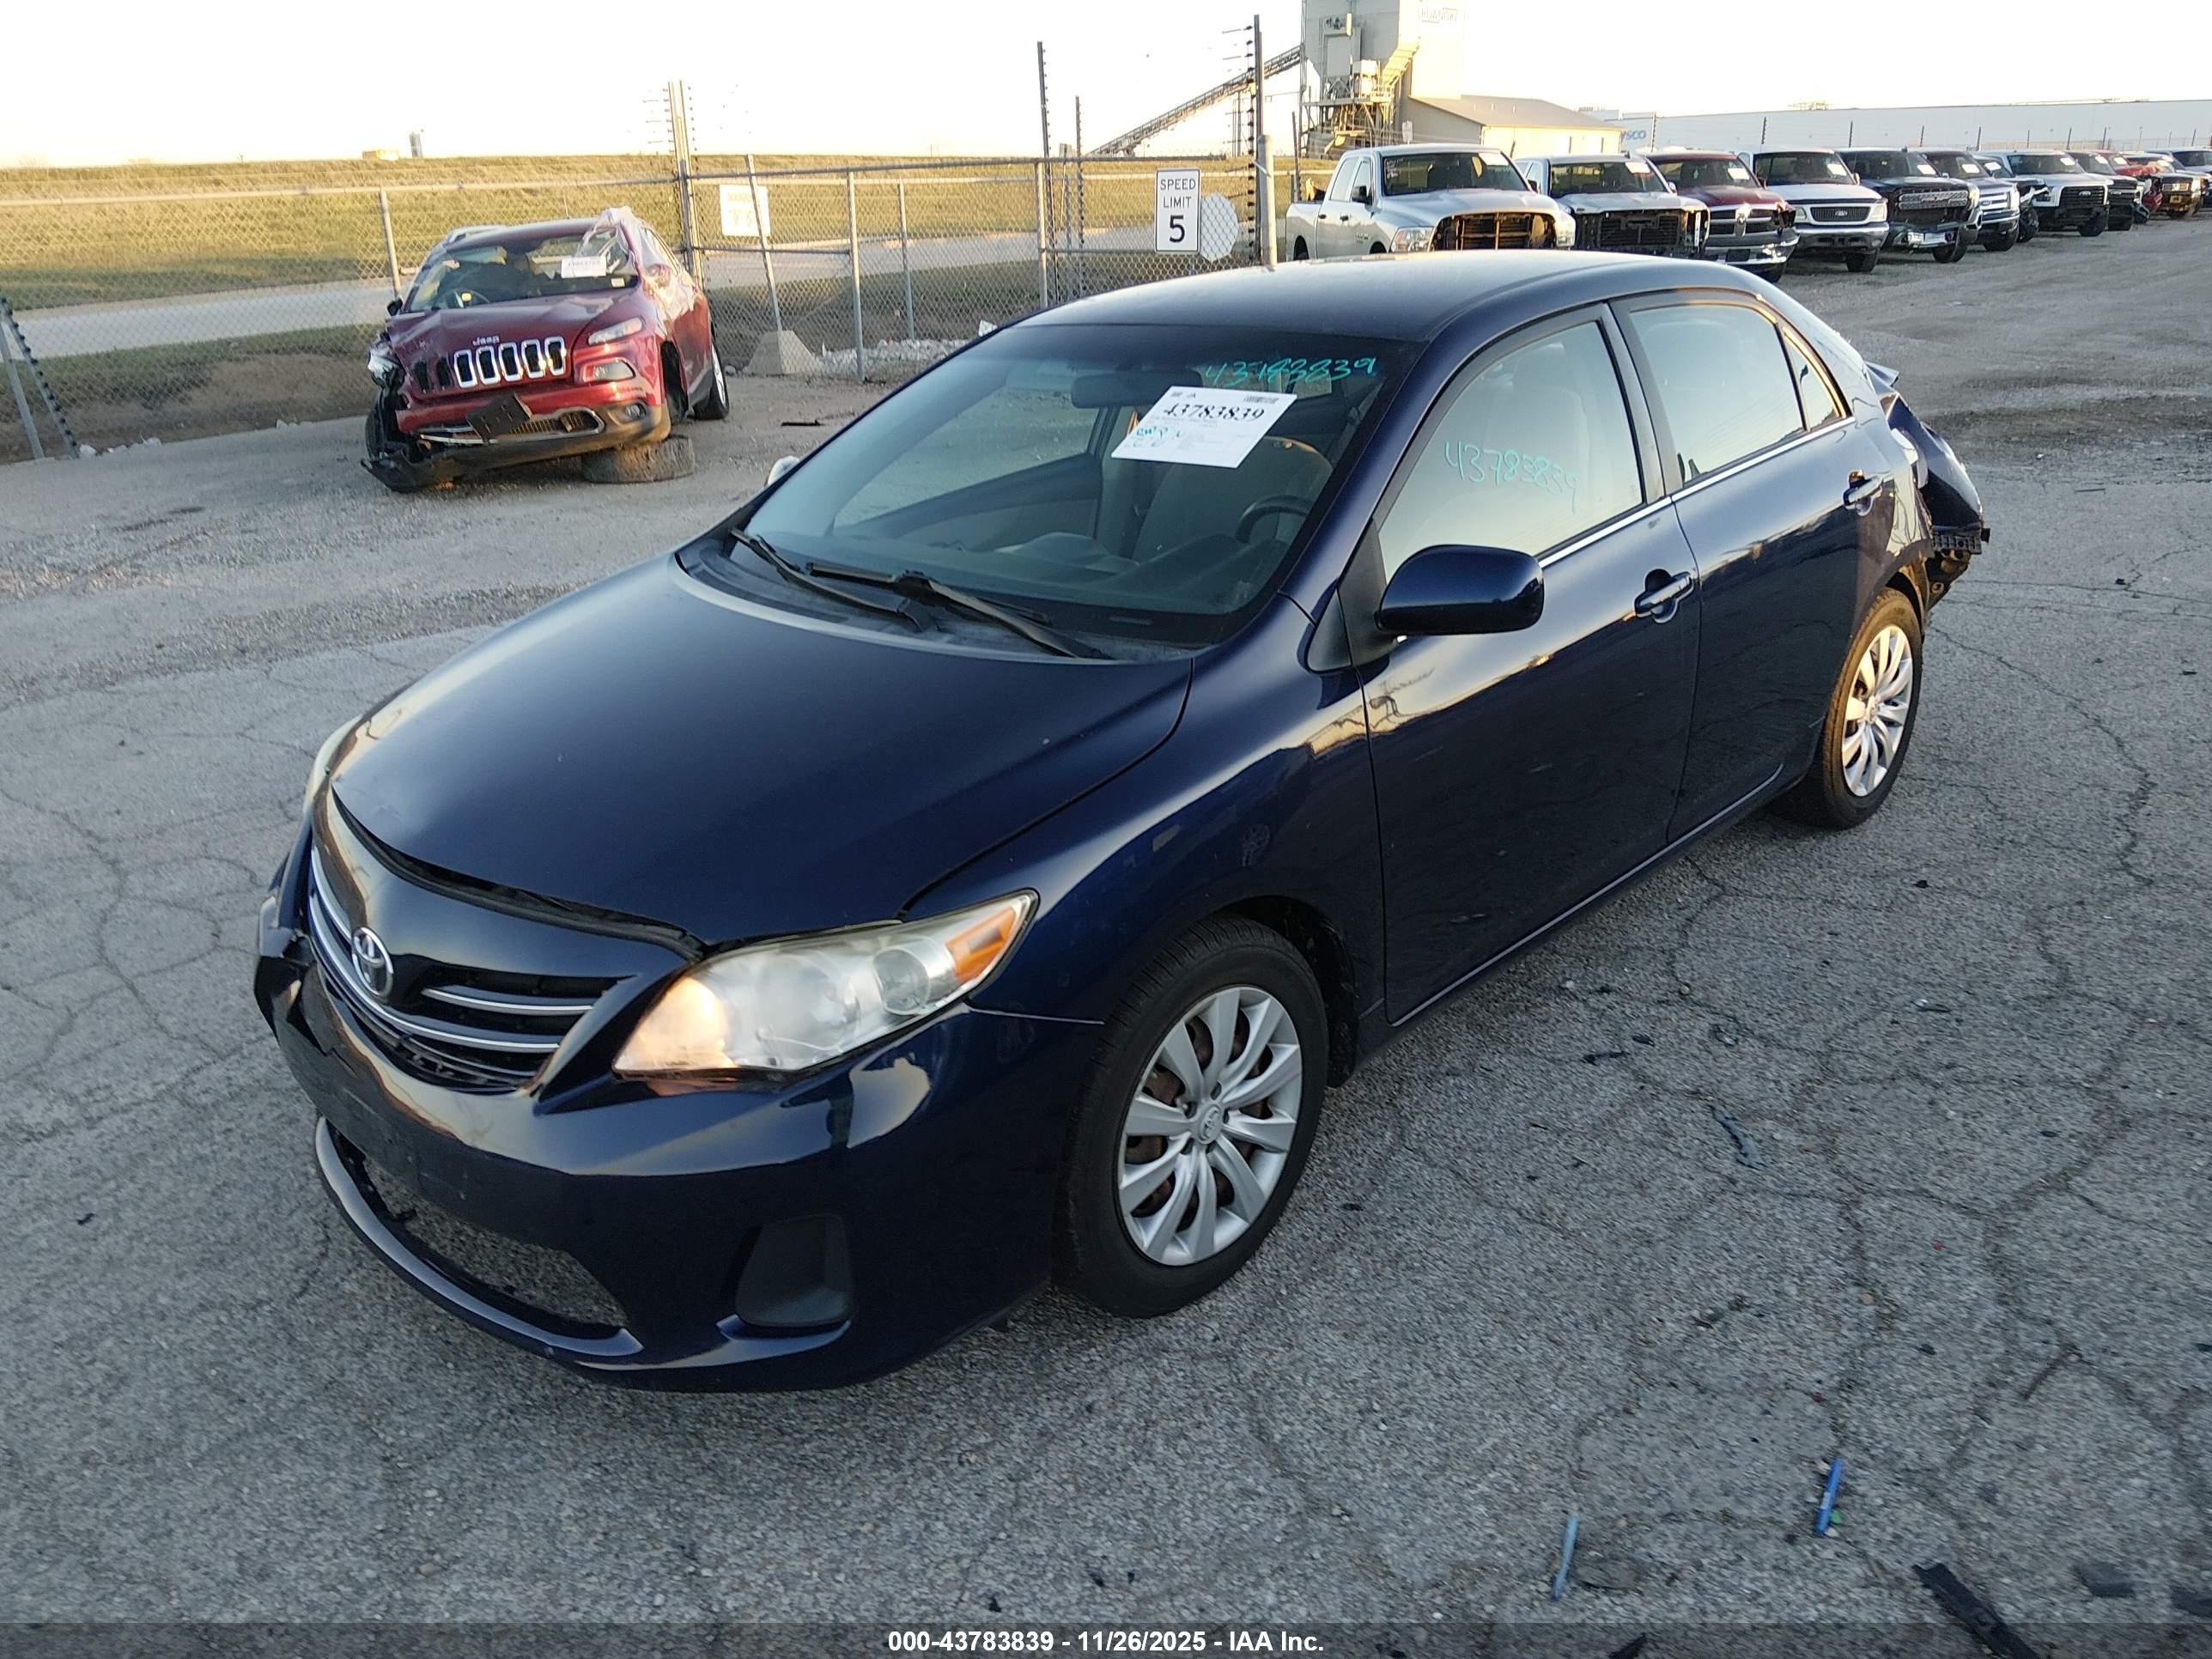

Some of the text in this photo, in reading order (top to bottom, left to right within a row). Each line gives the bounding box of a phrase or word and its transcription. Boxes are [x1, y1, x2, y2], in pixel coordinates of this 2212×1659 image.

[1617, 130, 1647, 143] YSCO
[1160, 179, 1196, 191] SPEED
[1163, 197, 1192, 209] LIMIT
[1169, 215, 1185, 243] 5
[472, 335, 500, 346] Jeep
[1163, 403, 1266, 422] 43783839
